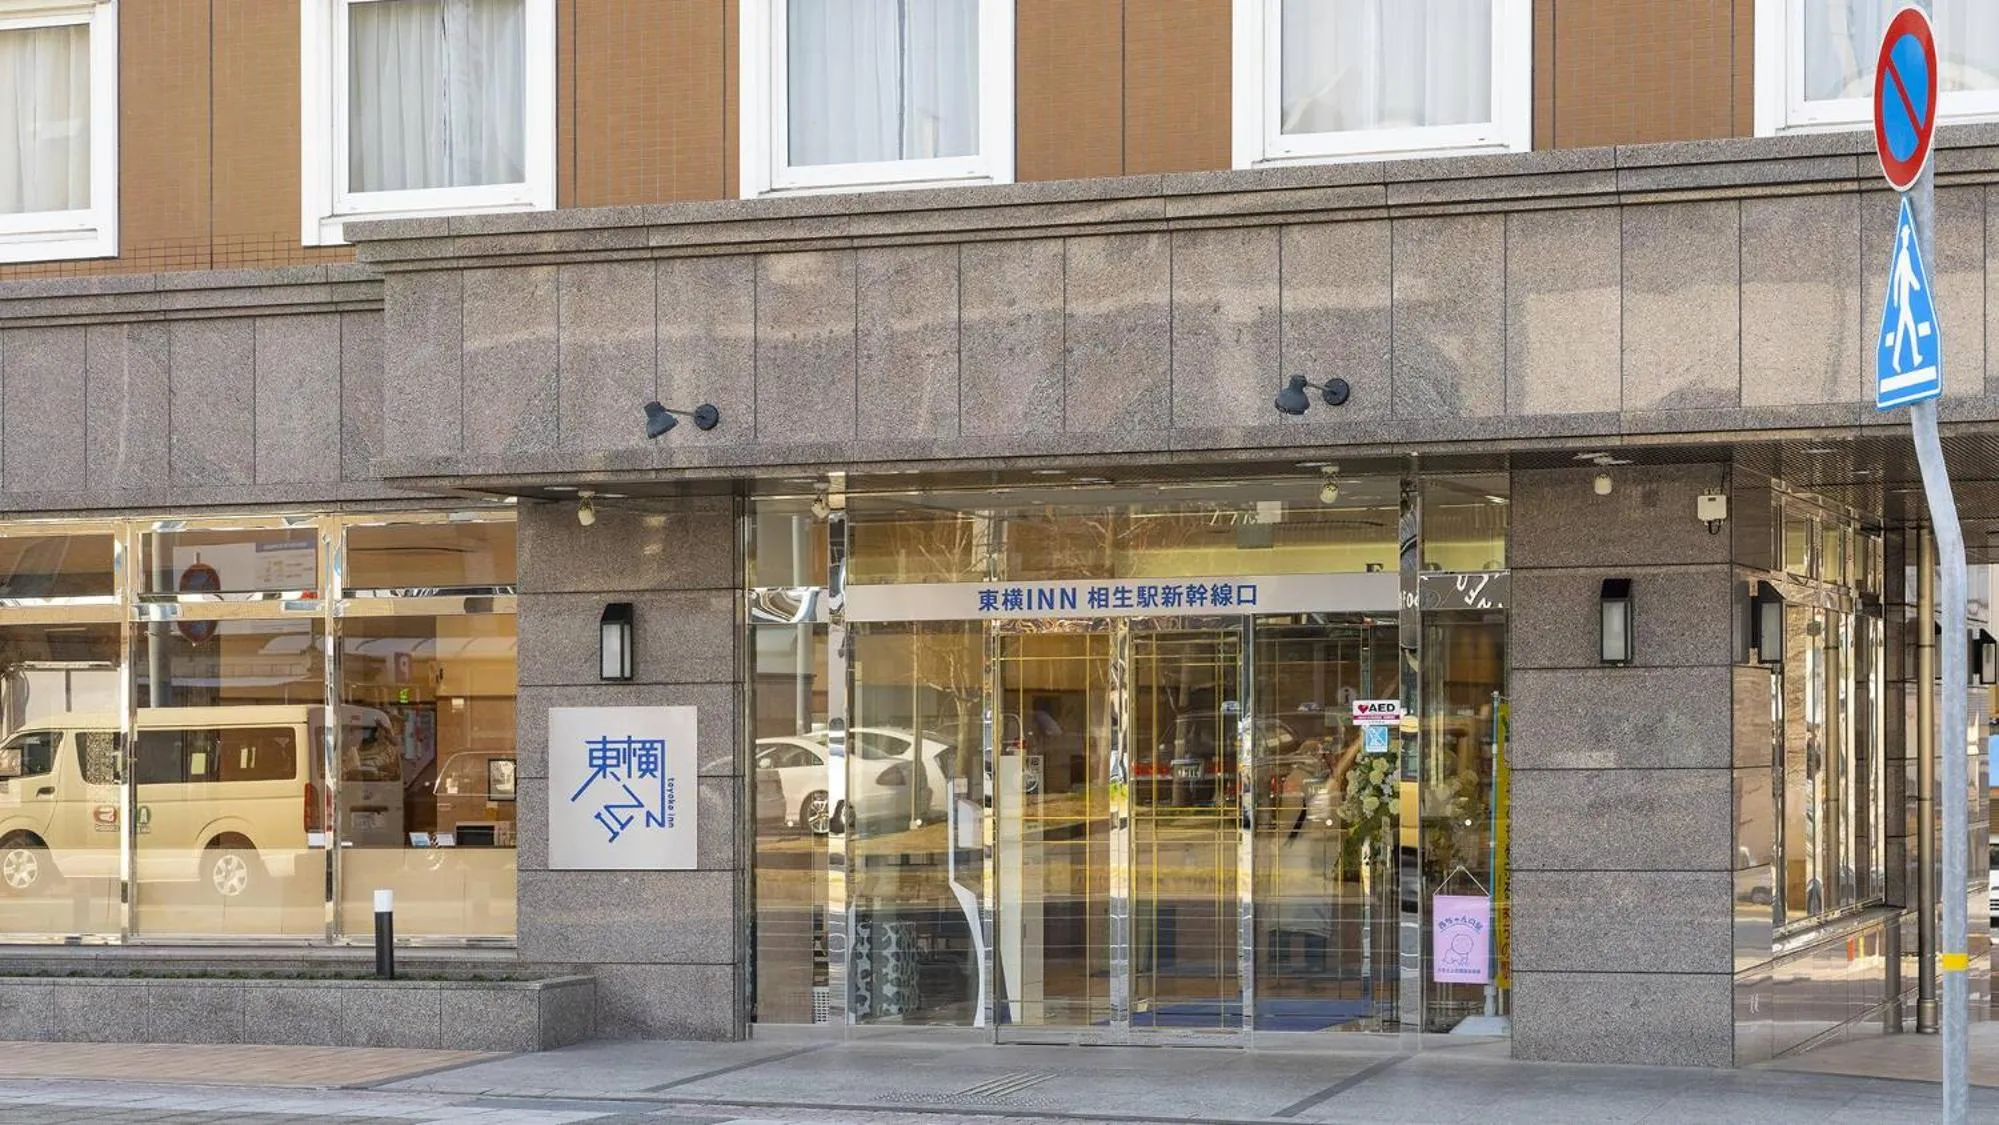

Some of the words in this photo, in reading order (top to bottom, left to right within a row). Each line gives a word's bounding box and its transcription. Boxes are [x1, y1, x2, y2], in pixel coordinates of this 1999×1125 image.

[978, 586, 1077, 612] 東横INN
[1087, 582, 1257, 610] 相生駅新幹線口
[1368, 703, 1395, 712] AED
[667, 777, 676, 811] toyoko
[667, 813, 675, 829] inn
